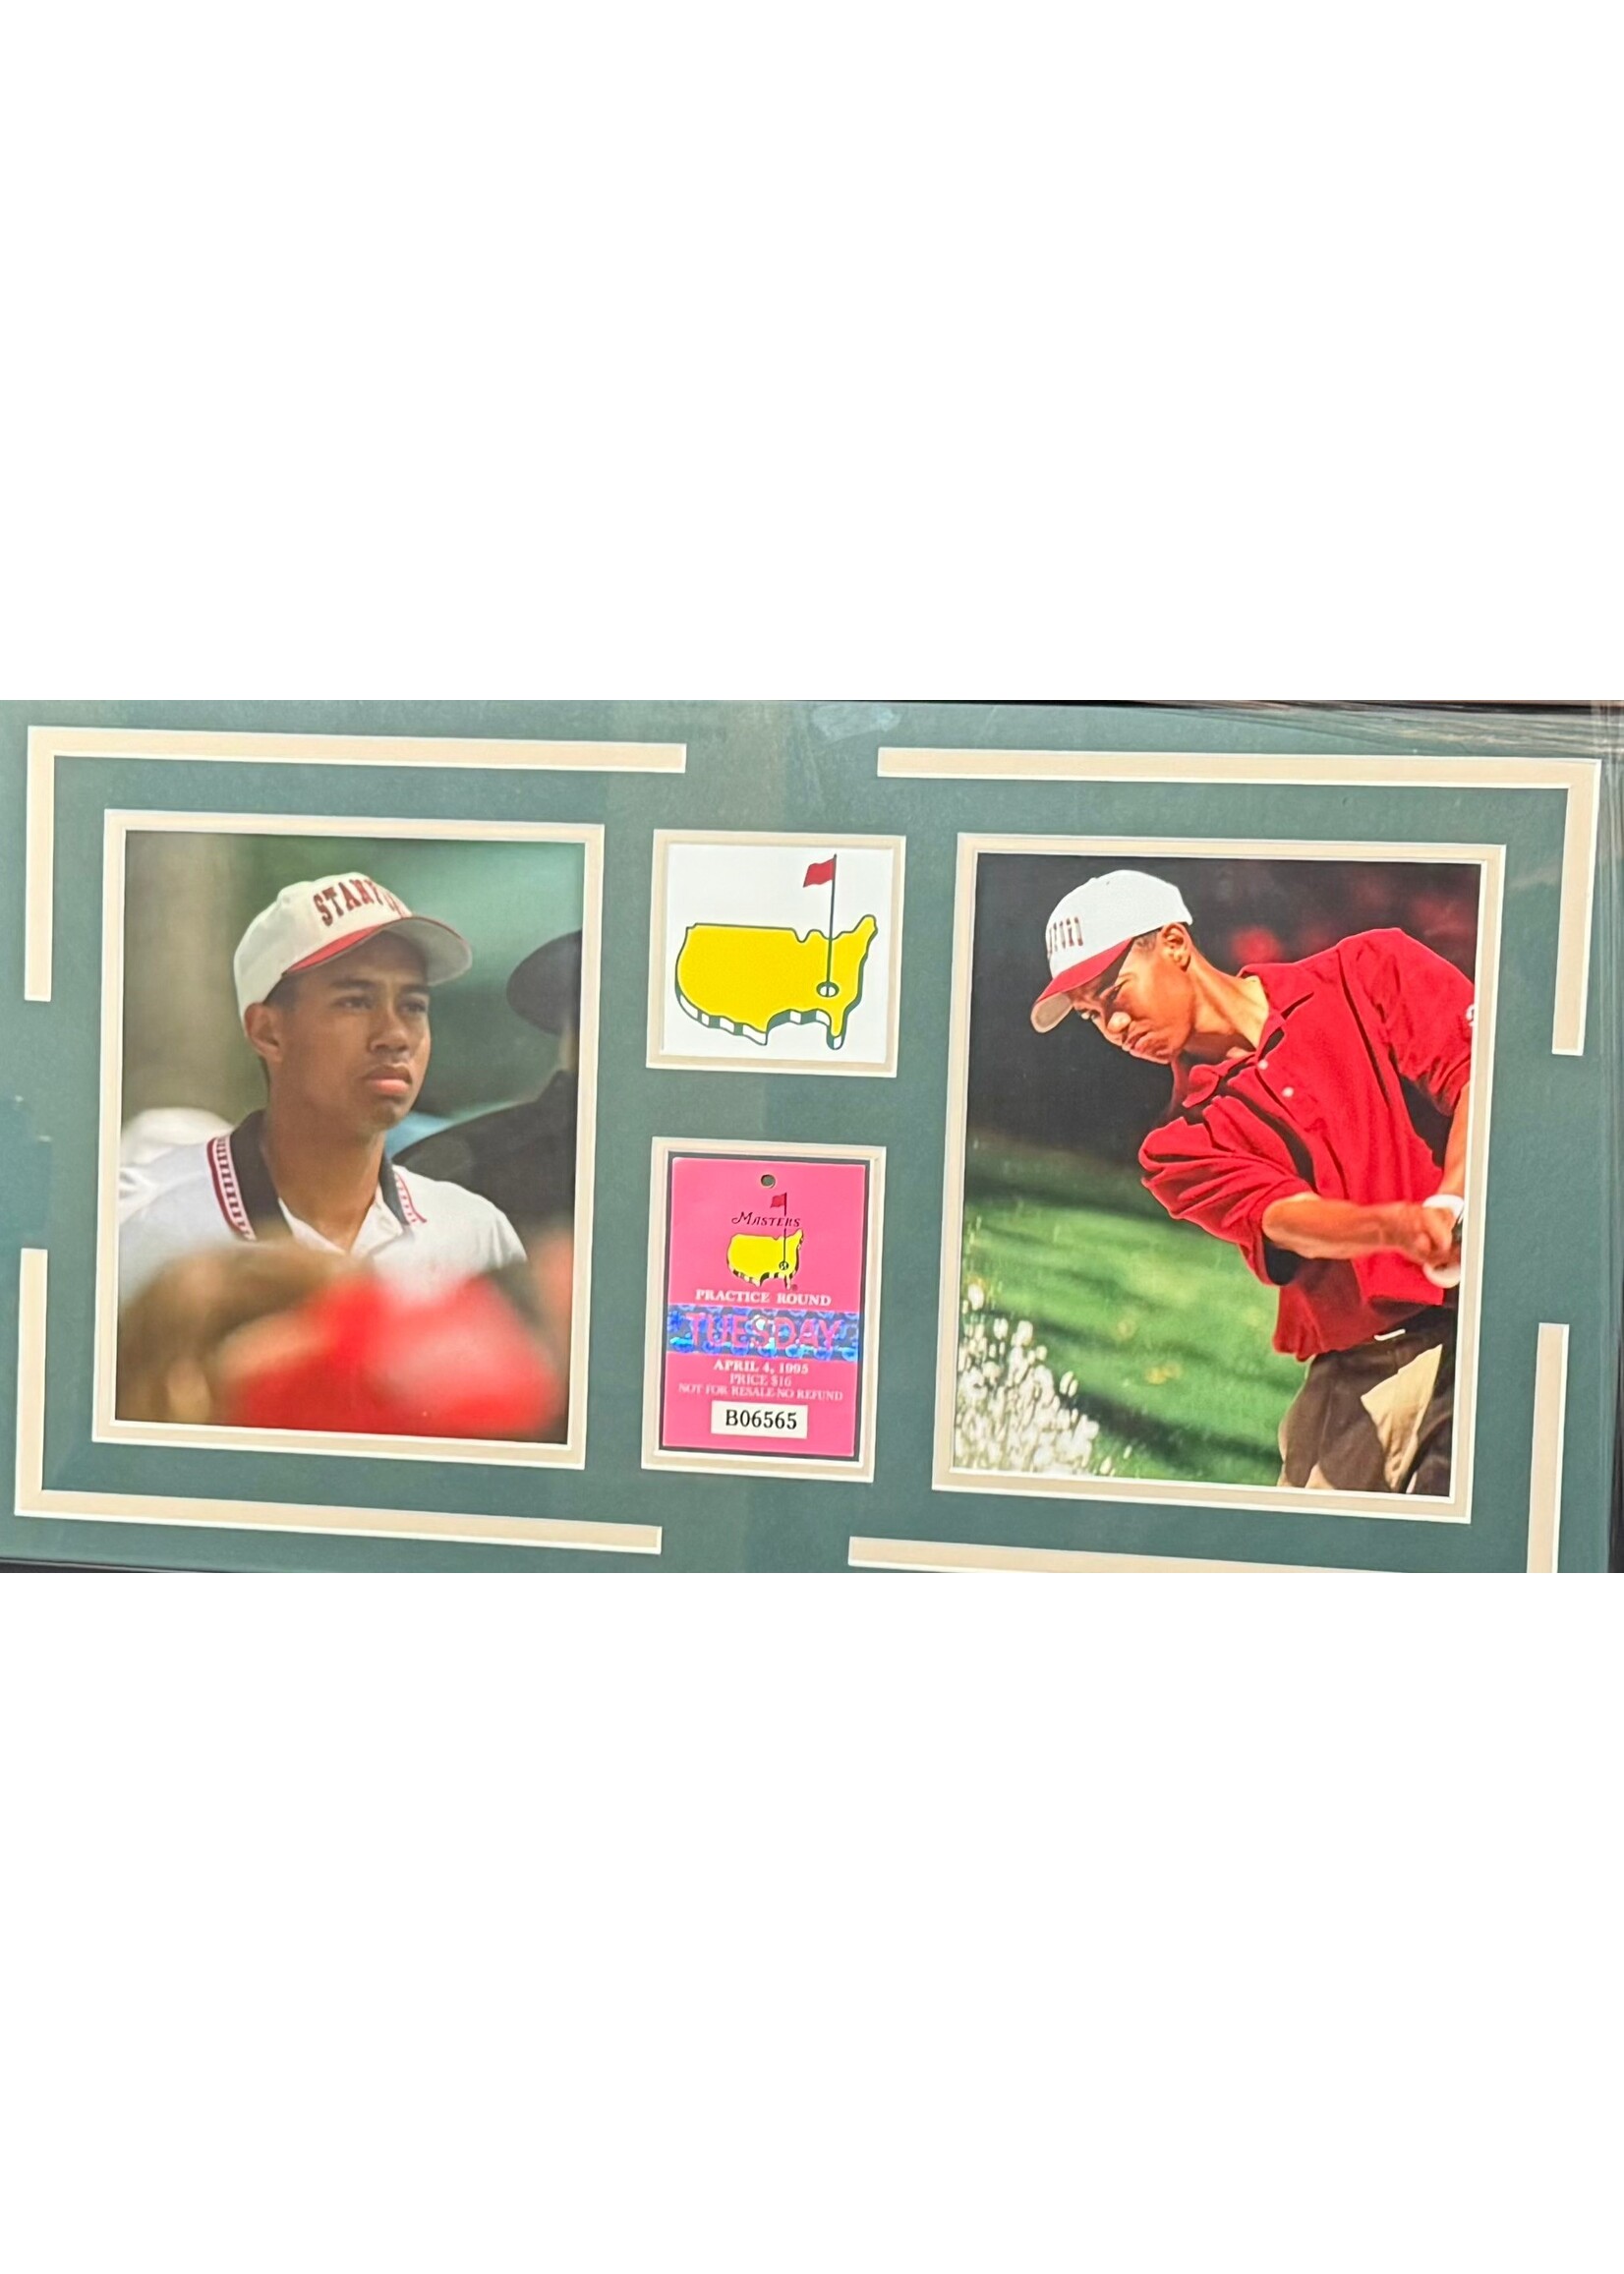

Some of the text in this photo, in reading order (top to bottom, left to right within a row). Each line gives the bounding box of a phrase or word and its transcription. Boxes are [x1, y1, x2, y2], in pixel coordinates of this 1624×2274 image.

[695, 1289, 832, 1307] PRACTICE ROUND
[685, 1312, 845, 1351] TUESDAY
[713, 1359, 809, 1375] APRIL 4, 1995
[729, 1372, 791, 1387] PRICE $16
[678, 1382, 703, 1394] NOT
[705, 1383, 727, 1395] FOR
[796, 1389, 843, 1401] REFUND
[725, 1409, 797, 1429] B06565
